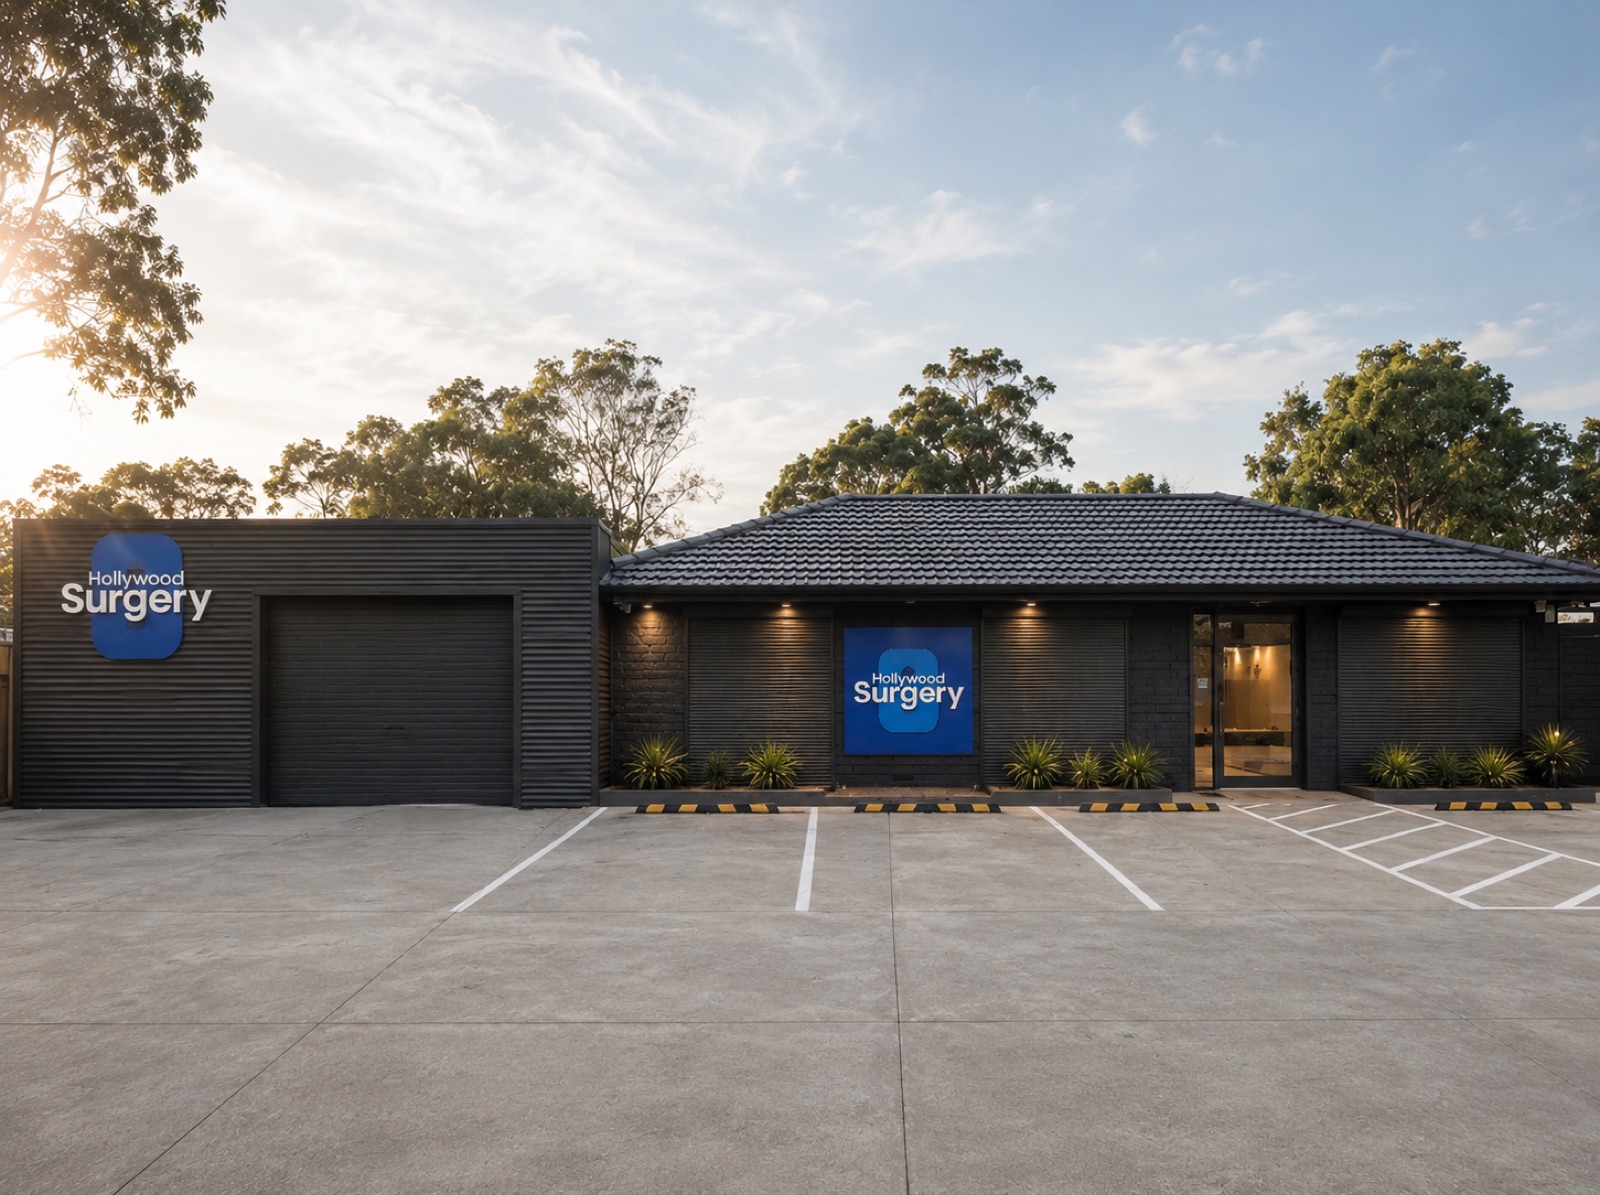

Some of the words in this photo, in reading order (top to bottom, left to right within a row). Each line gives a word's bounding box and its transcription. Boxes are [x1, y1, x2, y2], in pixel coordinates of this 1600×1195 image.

[88, 570, 184, 590] Hollywood
[61, 583, 213, 622] Surgery
[872, 672, 945, 687] Hollywood
[854, 681, 965, 710] Surgery
